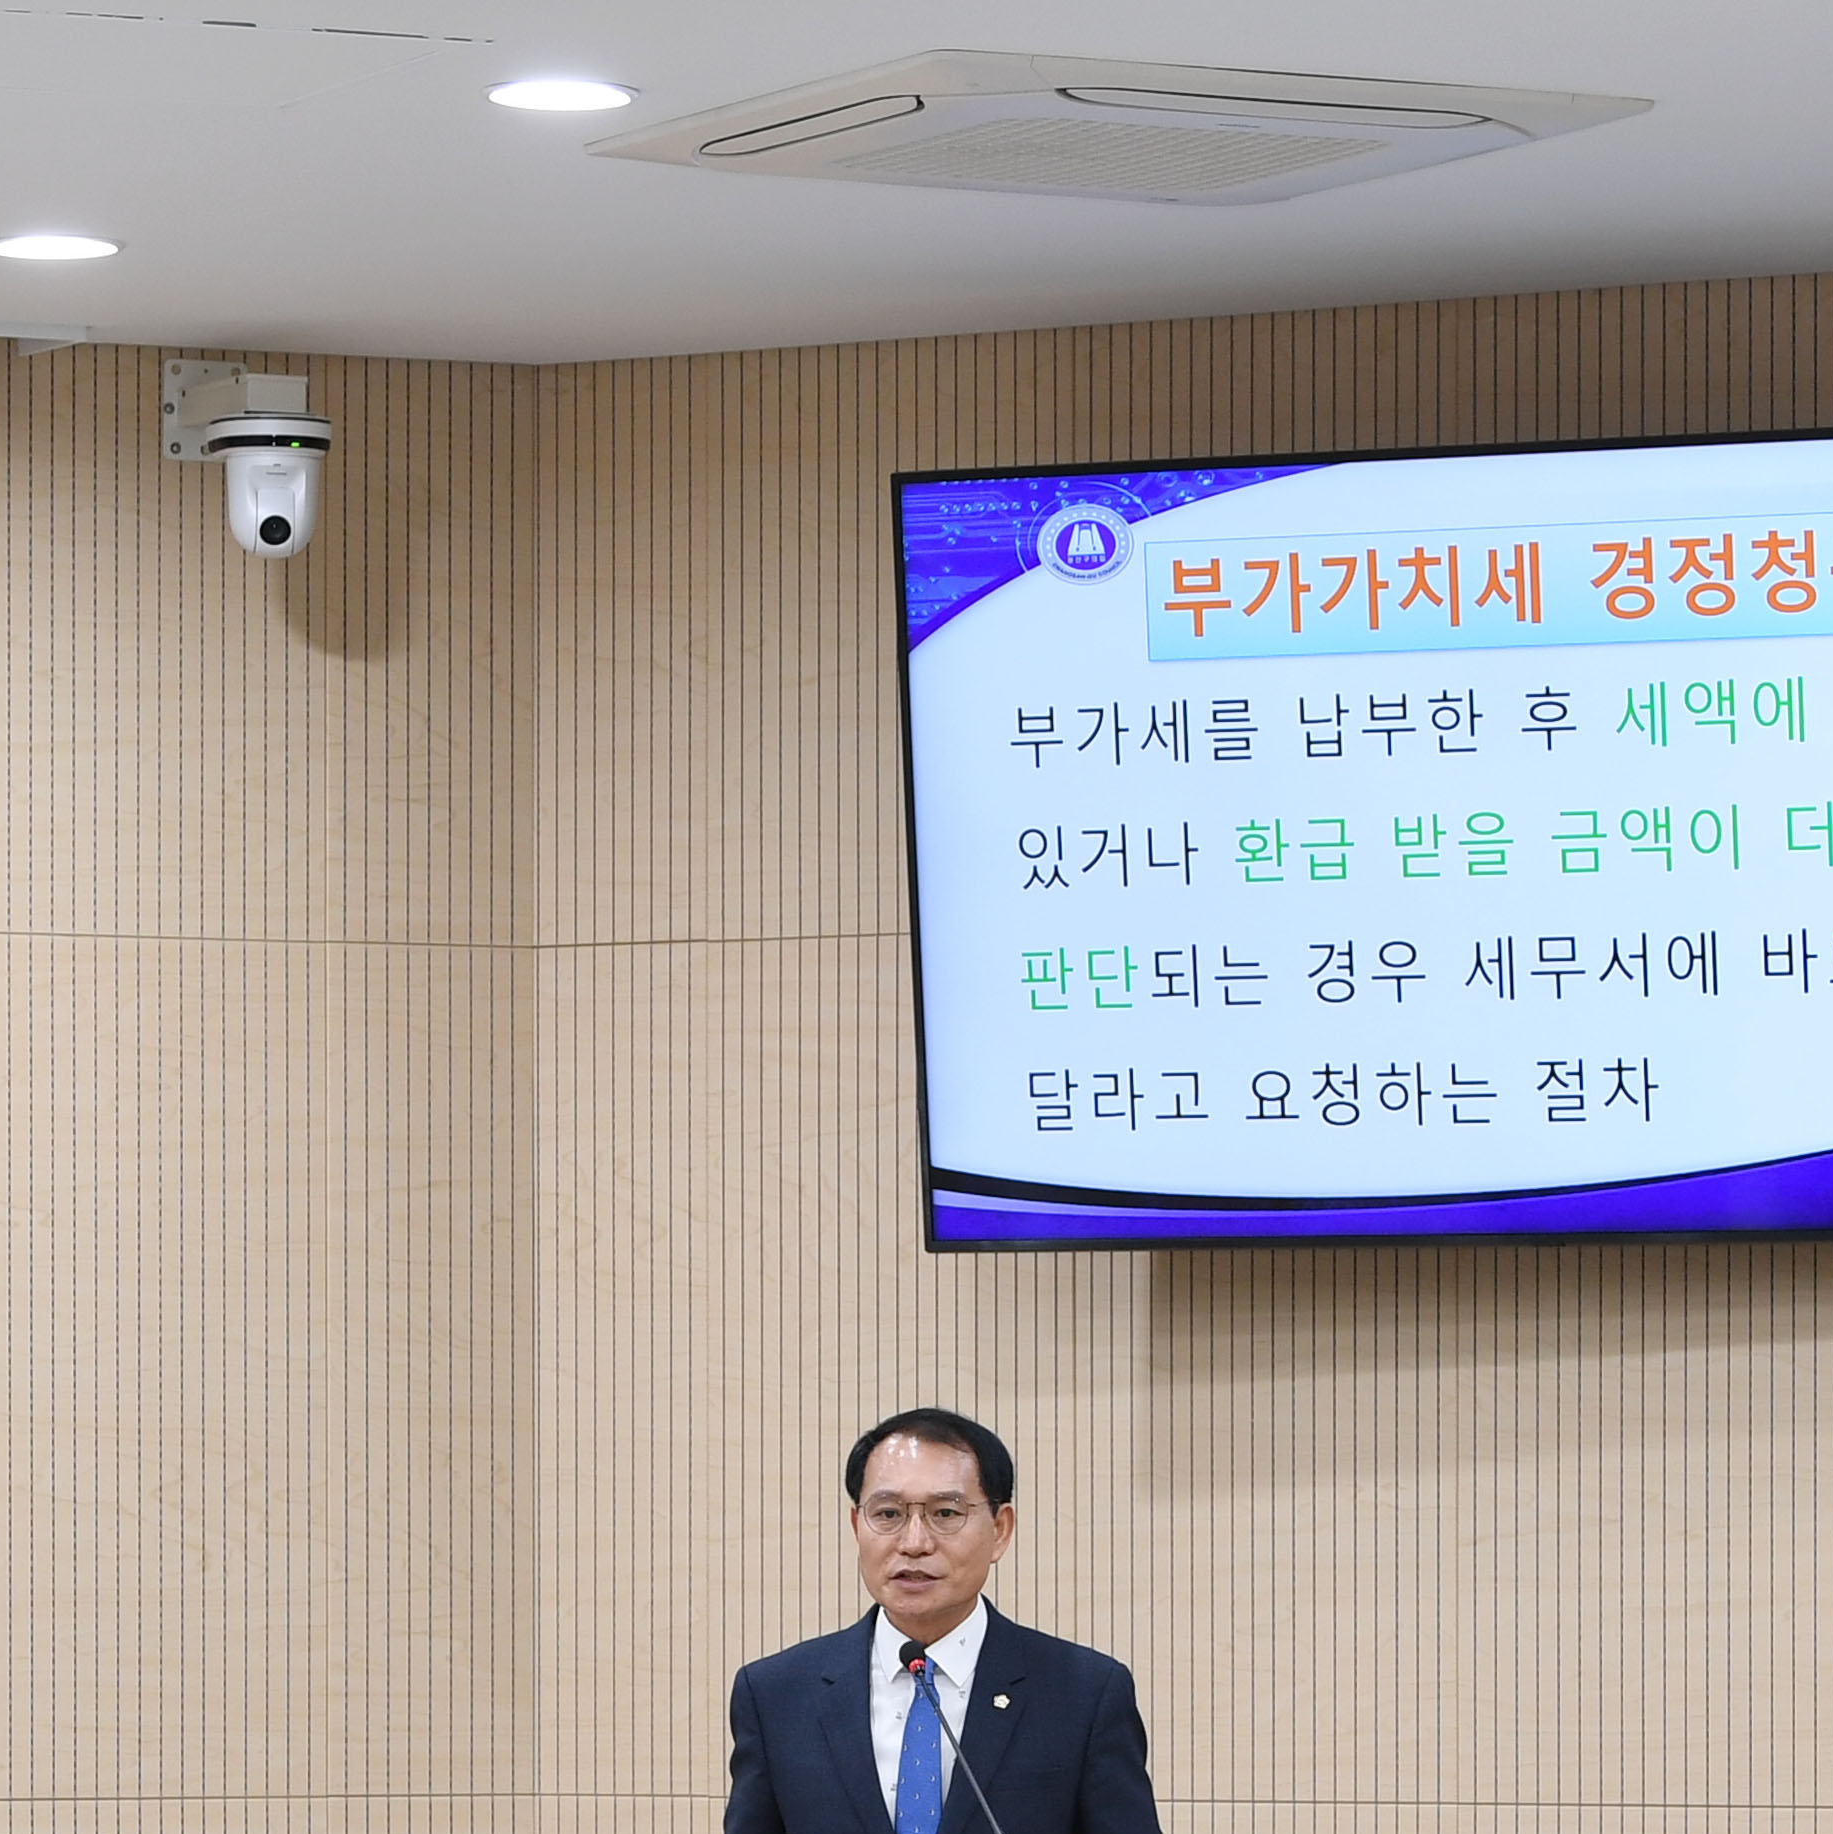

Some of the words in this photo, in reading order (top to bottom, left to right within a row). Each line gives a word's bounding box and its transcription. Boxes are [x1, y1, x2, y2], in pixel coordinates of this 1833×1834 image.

[1163, 542, 1545, 637] 부가가치세
[1010, 698, 1259, 769] 부가세를
[1299, 688, 1484, 758] 납부한
[1521, 685, 1578, 752] 후
[1616, 675, 1807, 748] 세액에
[1018, 821, 1199, 890] 있거나
[1234, 818, 1355, 883] 환급
[1393, 811, 1515, 878] 받을
[1551, 803, 1743, 874] 금액이
[1021, 943, 1269, 1011] 판단되는
[1307, 939, 1427, 1004] 경우
[1464, 930, 1722, 1001] 세무서에
[1028, 1067, 1210, 1132] 달라고
[1245, 1061, 1498, 1127] 요청하는
[1536, 1056, 1660, 1123] 절차
